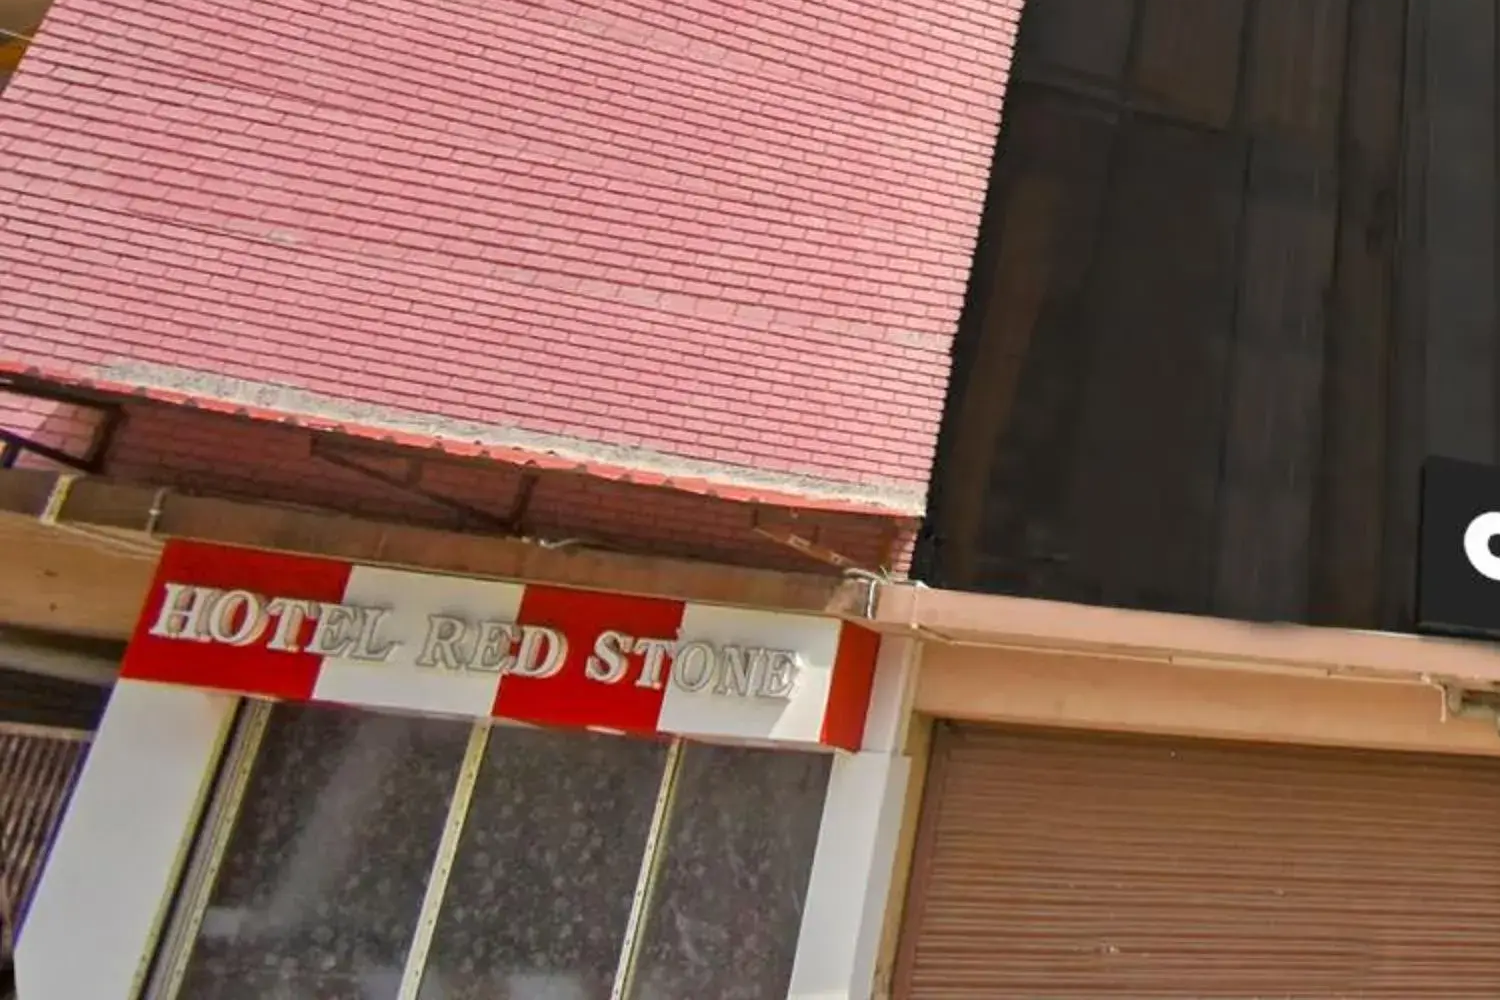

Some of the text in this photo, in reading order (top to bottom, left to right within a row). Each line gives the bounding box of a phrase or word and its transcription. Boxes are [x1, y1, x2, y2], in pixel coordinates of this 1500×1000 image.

[149, 583, 801, 699] HOTEL RED STONE
